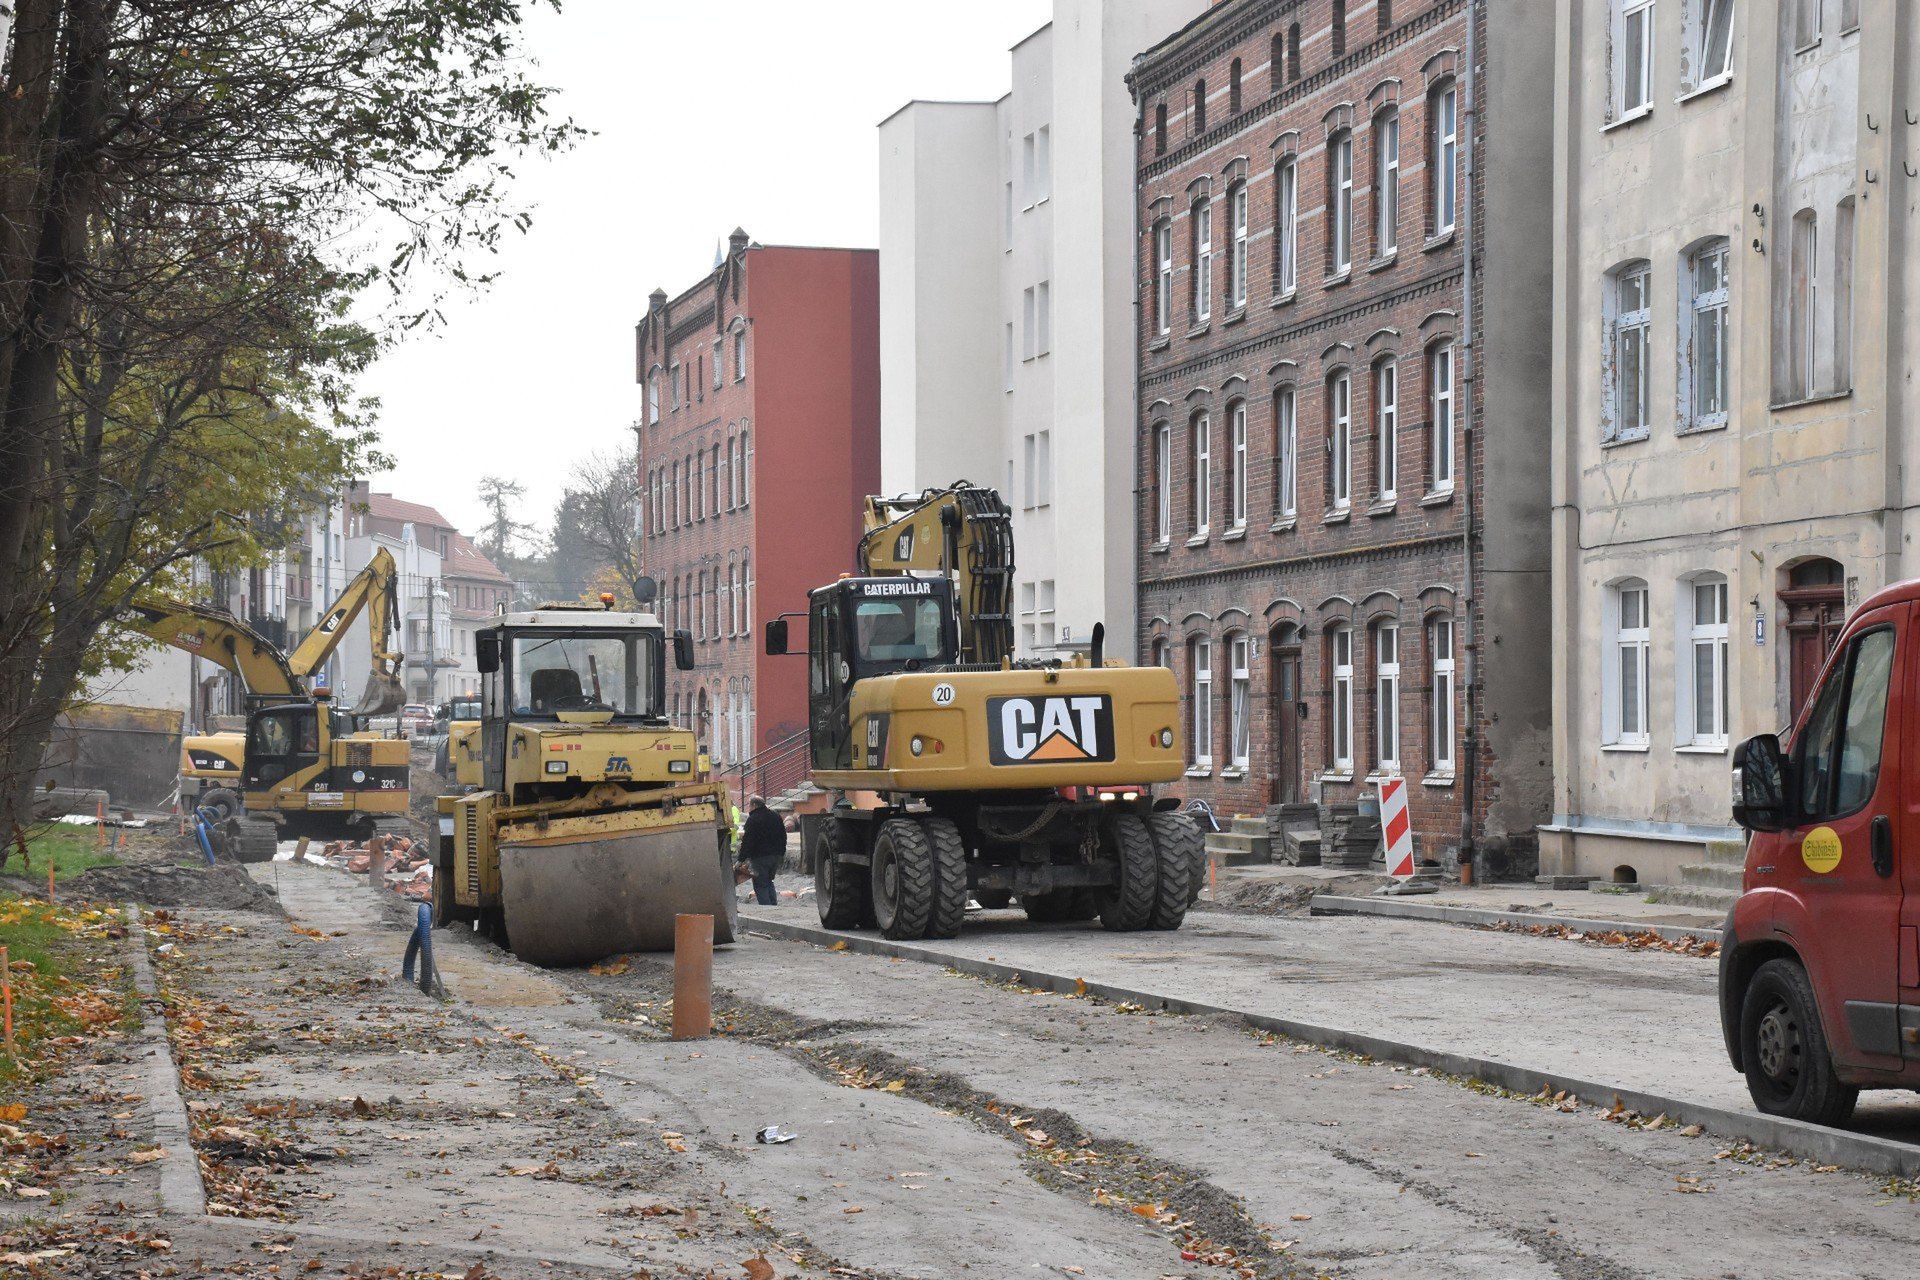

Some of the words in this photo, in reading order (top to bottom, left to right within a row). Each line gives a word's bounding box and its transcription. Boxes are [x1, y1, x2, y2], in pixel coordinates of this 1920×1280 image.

[864, 582, 931, 596] CATERPILLAR
[326, 613, 340, 631] CAT
[936, 687, 951, 702] 20
[1001, 696, 1103, 760] CAT
[213, 760, 226, 770] CAT
[314, 782, 329, 792] CAT
[380, 779, 396, 789] 321C
